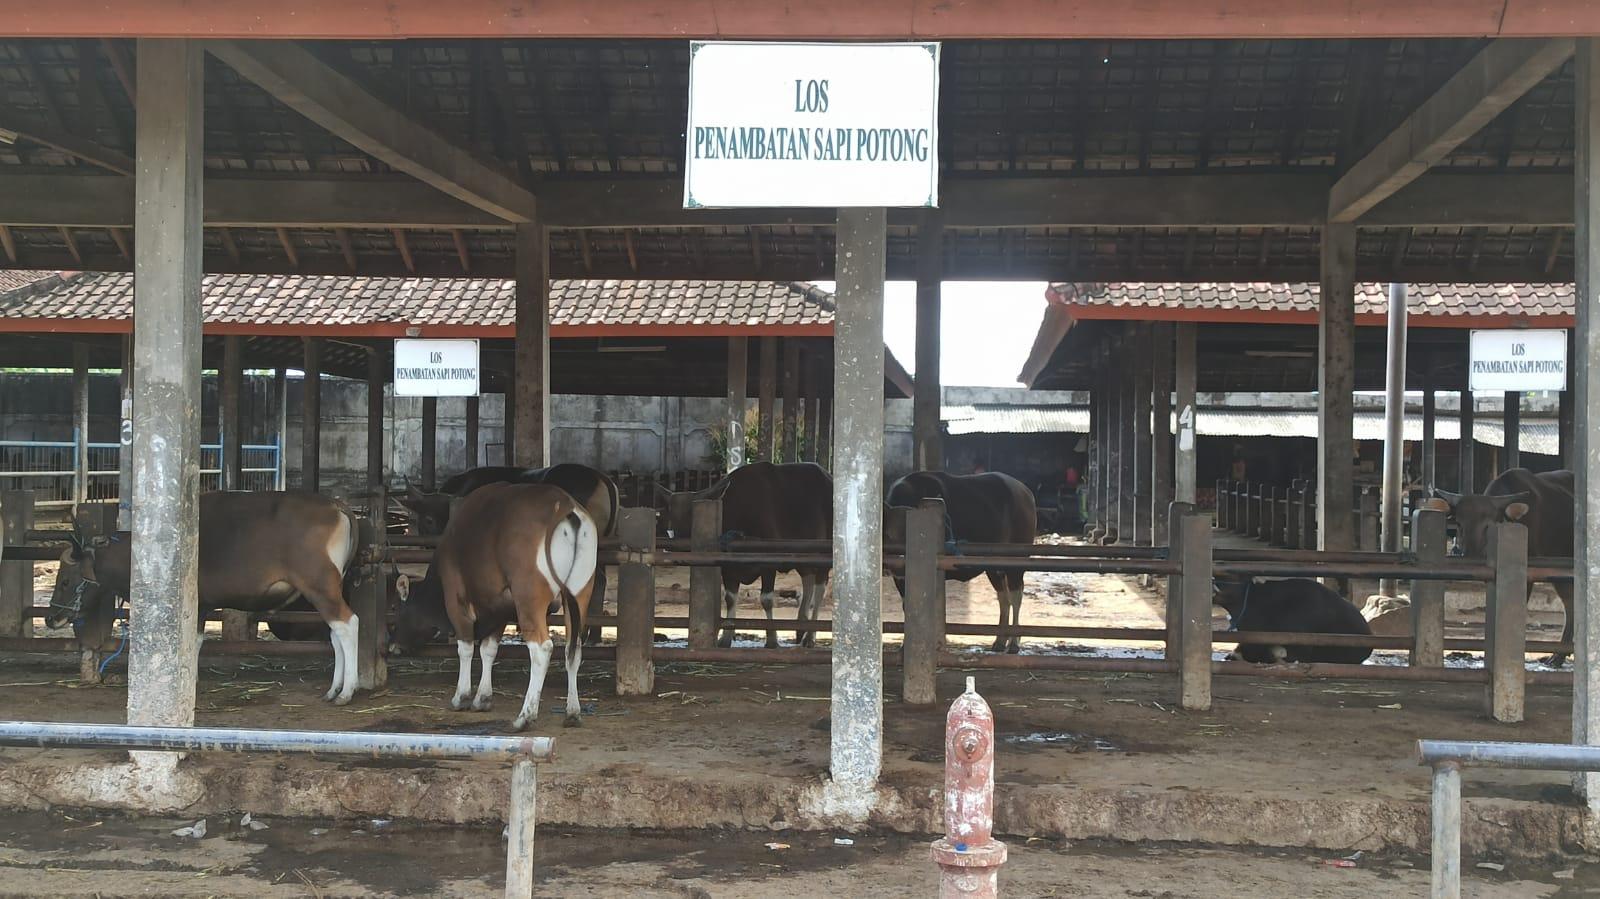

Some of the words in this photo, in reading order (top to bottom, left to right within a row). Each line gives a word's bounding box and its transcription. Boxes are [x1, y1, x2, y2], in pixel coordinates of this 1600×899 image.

[795, 79, 829, 112] LOS
[694, 126, 810, 161] PENAMBATAN
[814, 128, 852, 161] SAPI
[857, 128, 928, 162] POTONG
[1511, 343, 1525, 356] LOS
[430, 351, 442, 364] LOS
[396, 367, 436, 380] PENAMBATAN
[437, 367, 450, 380] SAPI
[451, 367, 476, 380] POTONG
[1473, 360, 1518, 374] PENAMBATAN
[1519, 360, 1534, 374] SAPI
[1535, 360, 1563, 374] POTONG
